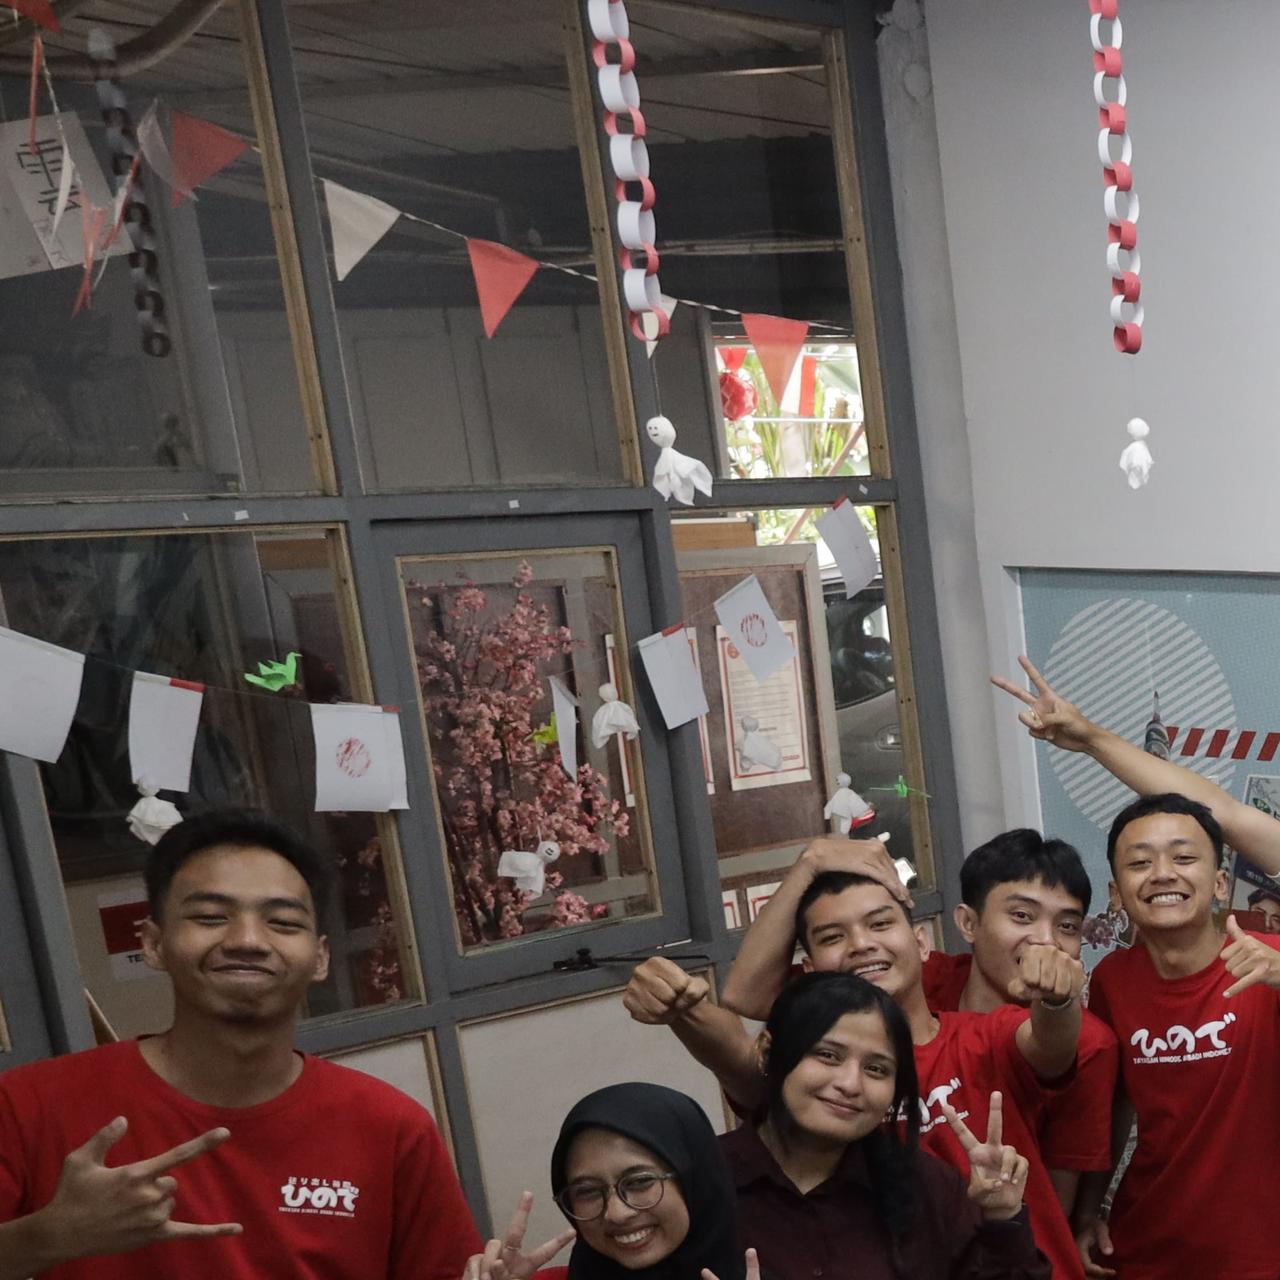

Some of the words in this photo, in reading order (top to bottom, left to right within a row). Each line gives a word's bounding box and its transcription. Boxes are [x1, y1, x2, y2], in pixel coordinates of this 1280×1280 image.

[1130, 1012, 1237, 1058] ひので
[281, 1184, 360, 1212] ひので
